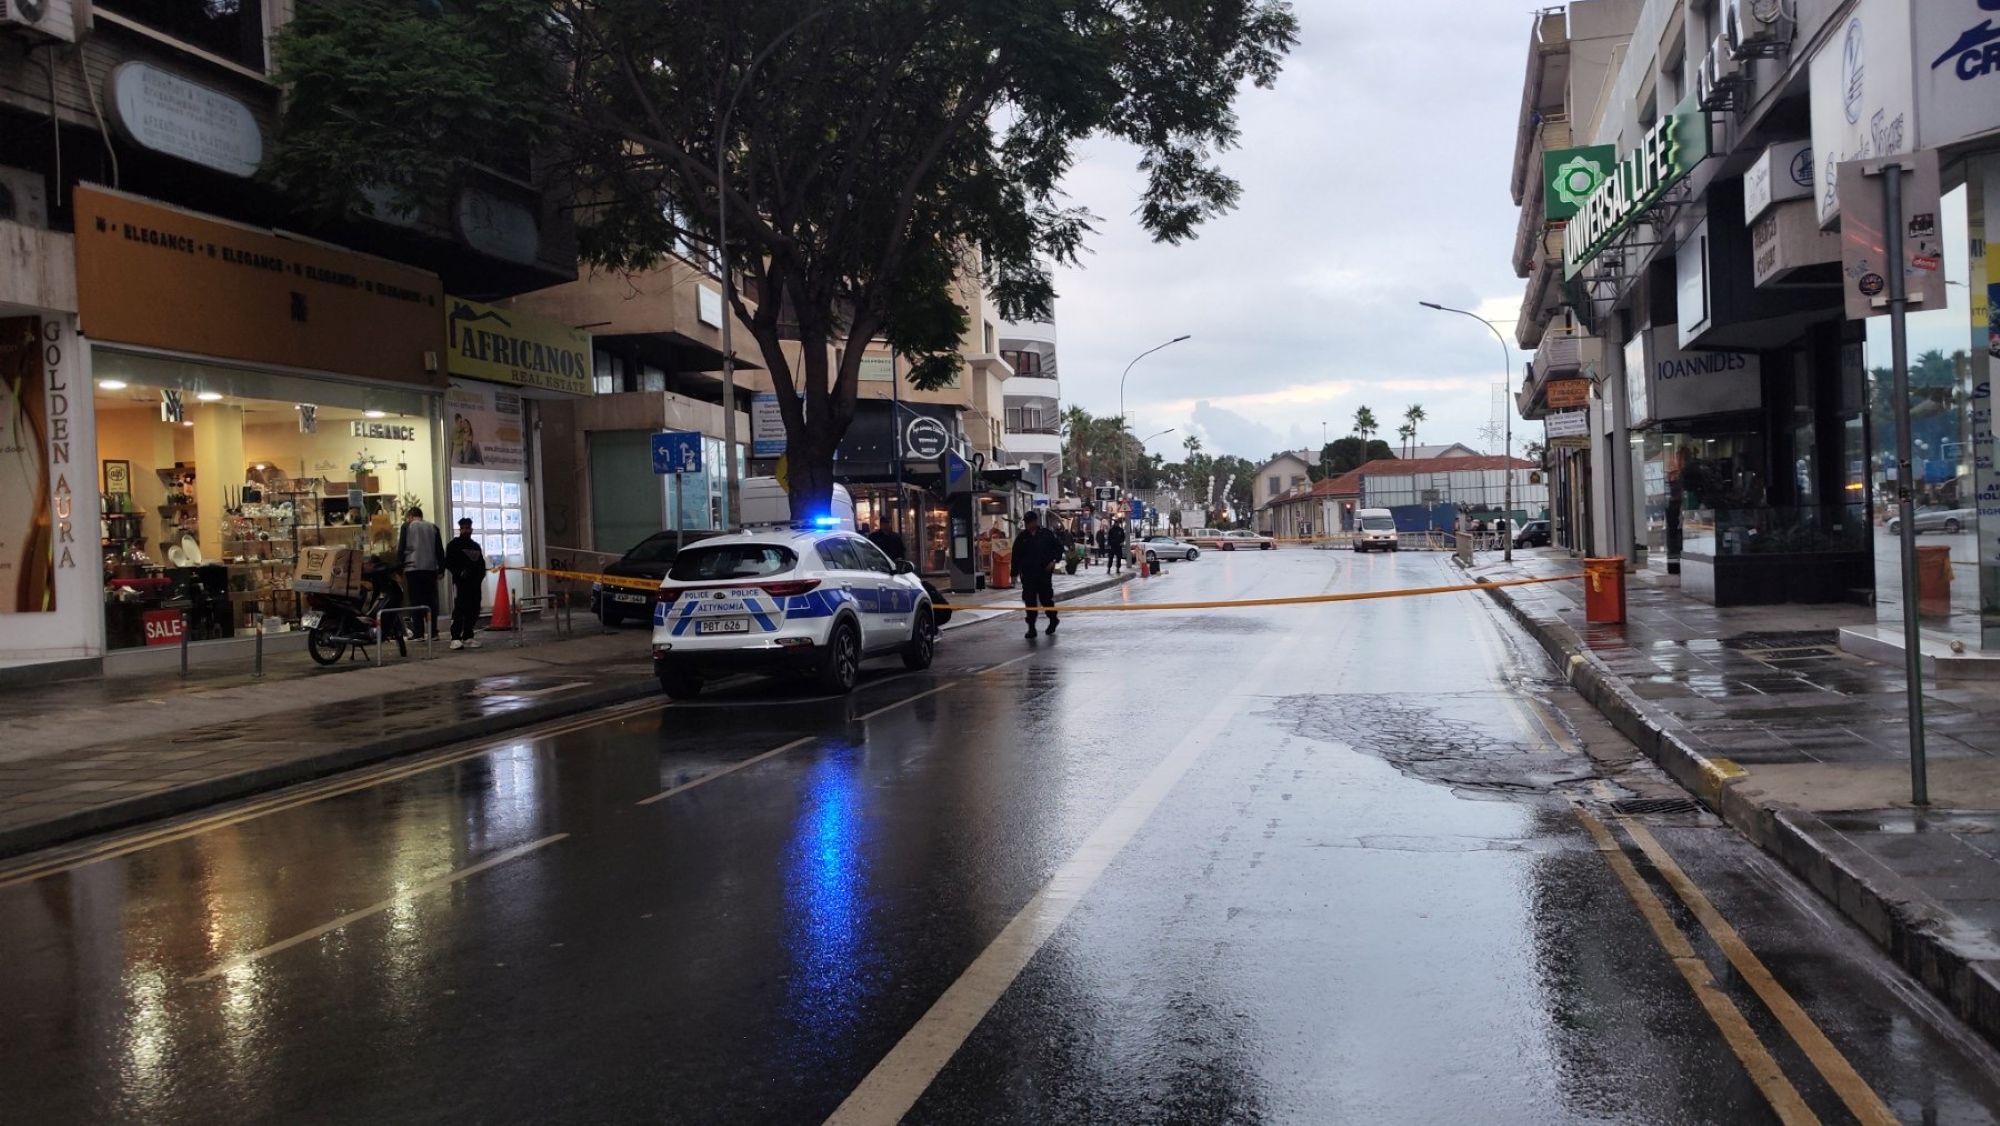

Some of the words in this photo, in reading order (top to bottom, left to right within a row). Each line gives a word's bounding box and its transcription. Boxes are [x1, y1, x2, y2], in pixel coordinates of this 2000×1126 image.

[1564, 161, 1632, 265] UNIVERSAL
[1632, 115, 1671, 202] LIFE
[124, 223, 194, 253] ELEGANCE
[222, 246, 283, 272] ELEGANCE
[462, 327, 586, 381] AFRICANOS
[1658, 352, 1746, 381] IOANNIDES
[43, 320, 69, 465] GOLDEN
[511, 369, 543, 386] REAL
[546, 374, 586, 393] ESTATE
[351, 421, 415, 441] ELEGANCE
[55, 472, 76, 569] AURA
[685, 591, 709, 600] POLICE
[731, 588, 760, 597] POLICE
[146, 619, 182, 639] SALE
[724, 620, 741, 631] 626
